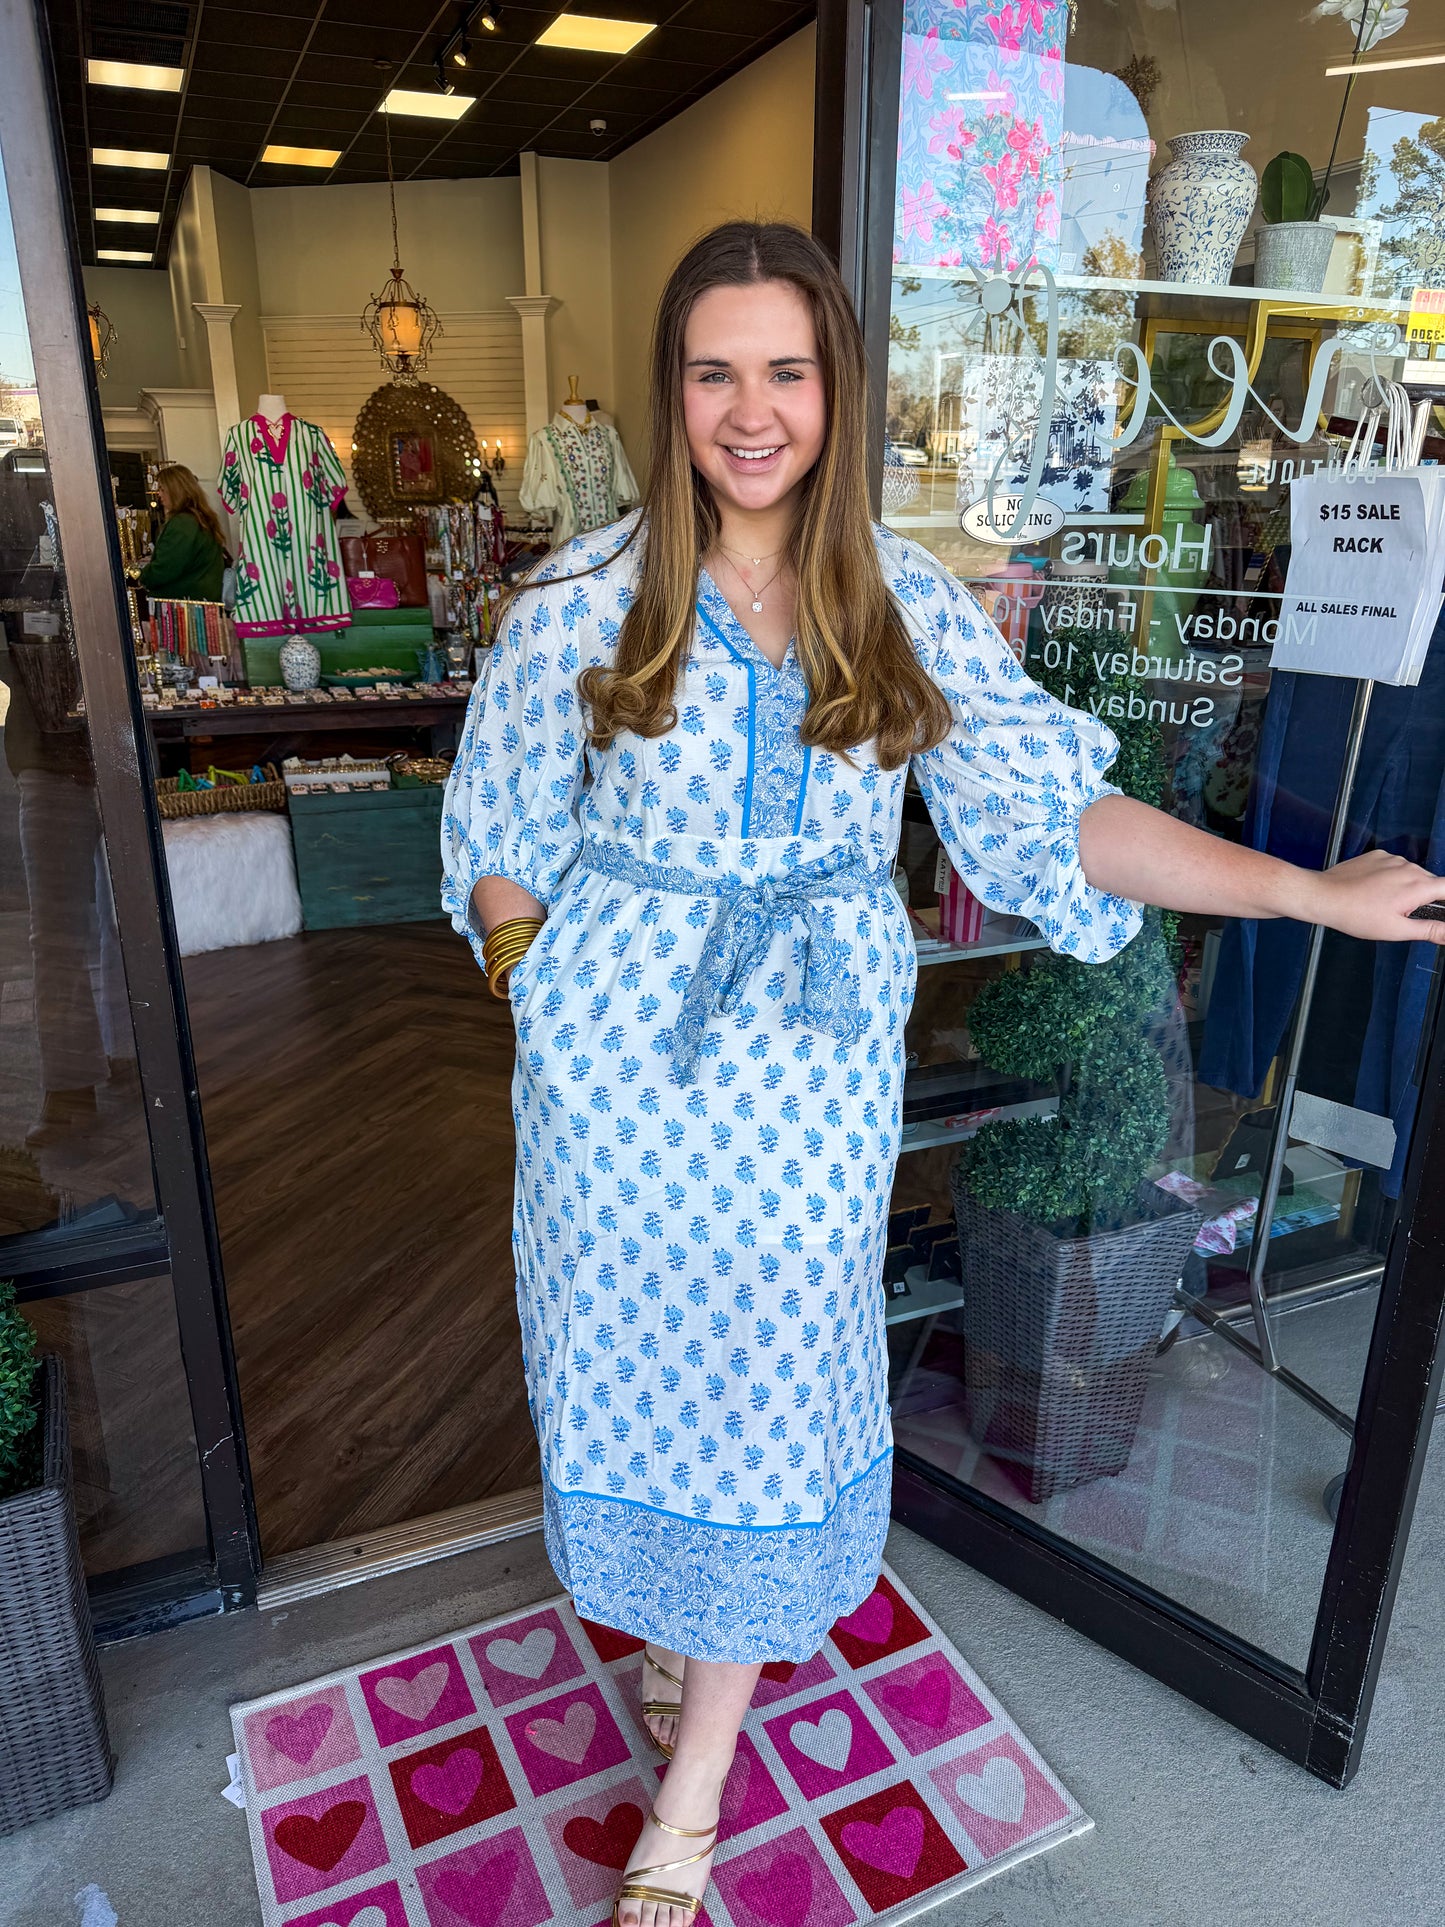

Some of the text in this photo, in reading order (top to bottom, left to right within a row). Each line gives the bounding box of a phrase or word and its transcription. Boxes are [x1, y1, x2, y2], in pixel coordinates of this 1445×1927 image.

[976, 513, 1052, 527] SOLICING
[1319, 504, 1401, 522] $15 SALE
[1332, 537, 1384, 553] RACK
[1295, 602, 1398, 618] ALL SALES FINAL
